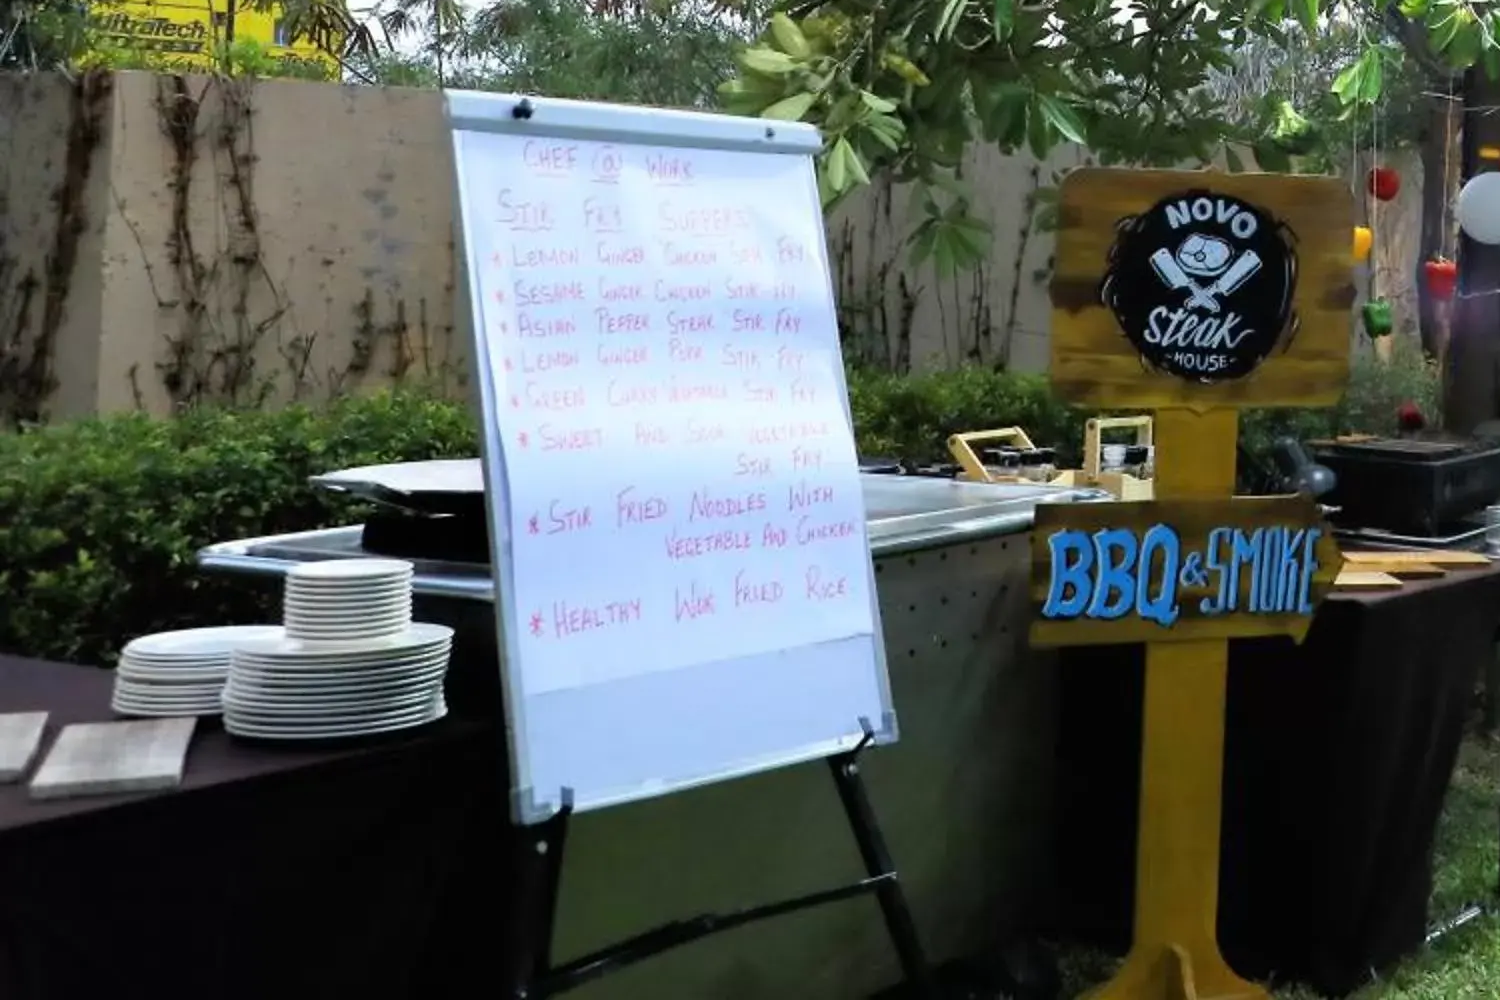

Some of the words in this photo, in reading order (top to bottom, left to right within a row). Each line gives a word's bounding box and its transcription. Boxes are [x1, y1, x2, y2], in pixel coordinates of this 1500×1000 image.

[1164, 197, 1258, 240] NOVO
[1143, 305, 1254, 349] Steak
[1042, 523, 1180, 628] BBQ
[1200, 526, 1323, 617] SMOKE
